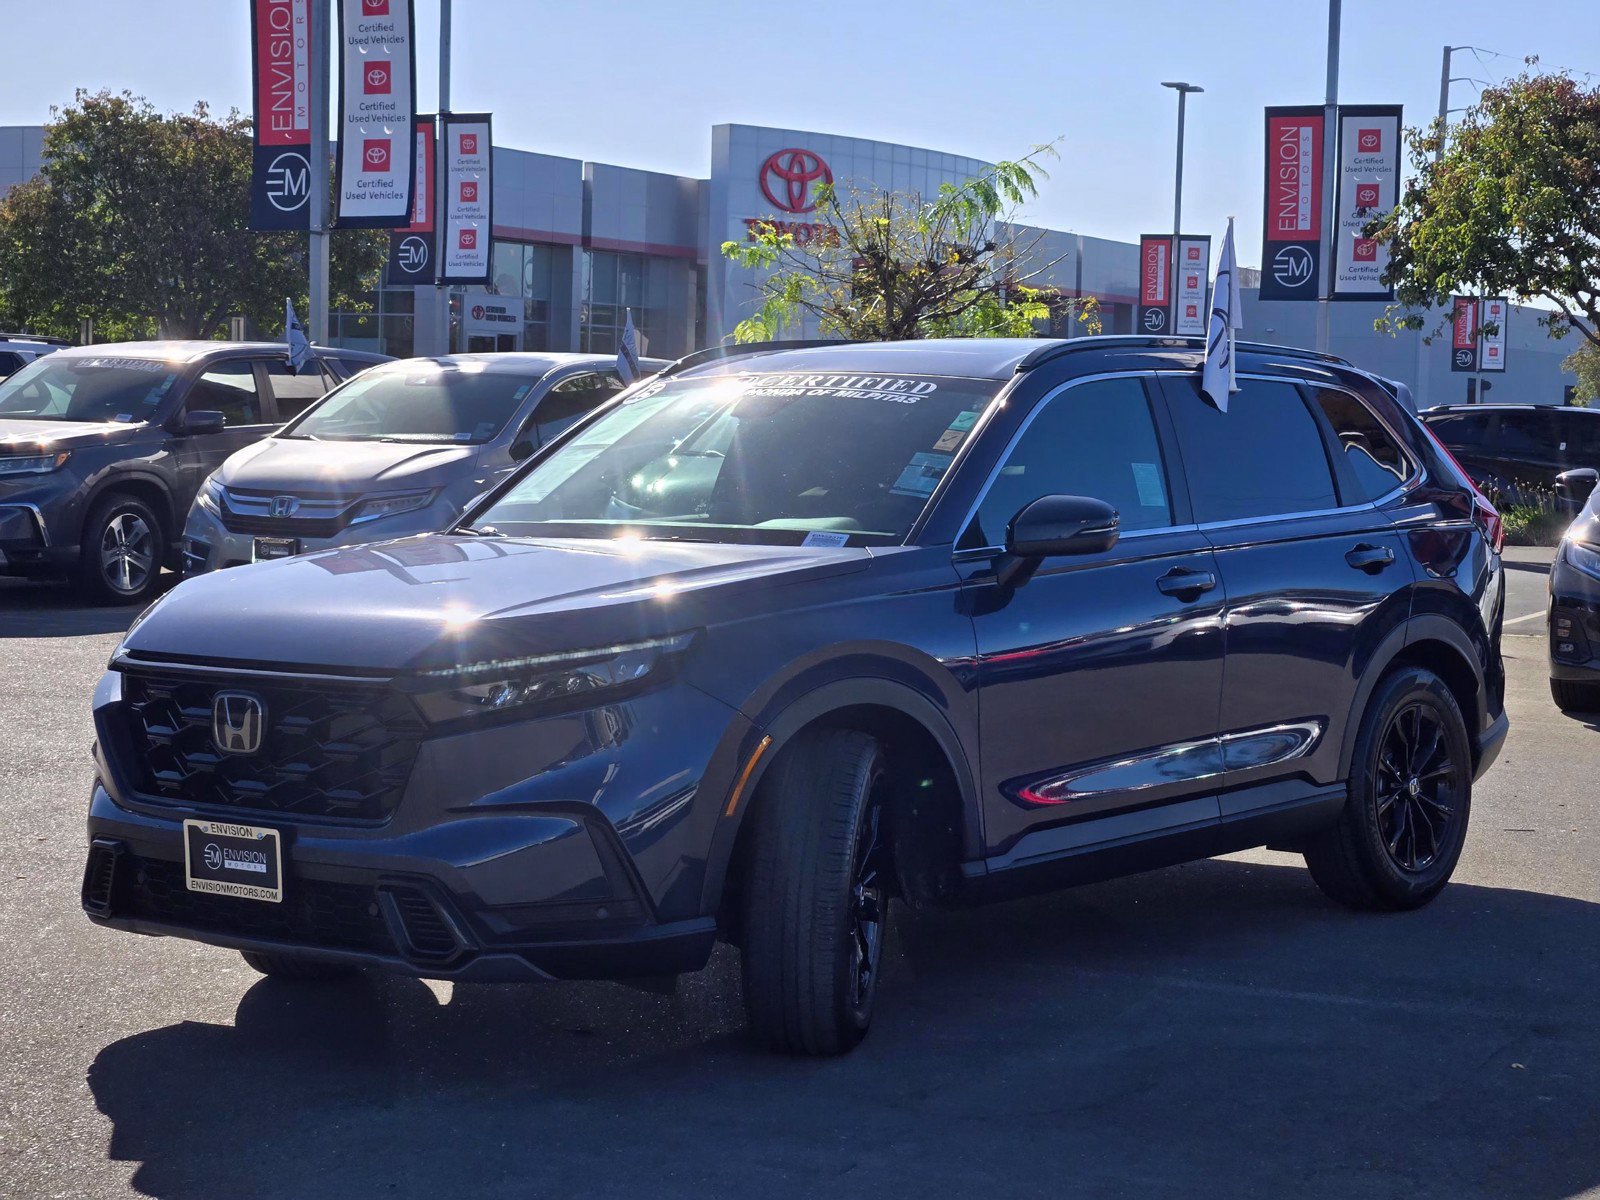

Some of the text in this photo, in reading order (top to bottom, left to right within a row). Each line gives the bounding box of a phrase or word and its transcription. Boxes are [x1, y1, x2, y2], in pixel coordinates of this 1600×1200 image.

[358, 22, 394, 33] Certified
[348, 35, 405, 45] Used Vehicles
[270, 0, 292, 131] ENVISIO
[359, 102, 396, 111] Certified
[348, 113, 406, 123] Used Vehicles
[1353, 157, 1384, 165] Certified
[1363, 165, 1392, 173] Vehicles
[356, 179, 394, 188] Certified
[1278, 126, 1298, 231] ENVISION
[1300, 135, 1310, 222] MOTORS
[345, 191, 404, 200] Used Vehicles
[1342, 220, 1360, 228] Used
[1147, 244, 1158, 301] ENVISION
[805, 389, 835, 397] OF
[832, 390, 921, 404] MILPITAS
[210, 823, 253, 838] ENVISION
[223, 848, 267, 864] ENVISION
[227, 862, 264, 871] MOTORS
[191, 880, 278, 901] ENVISIONMOTORS.COM
